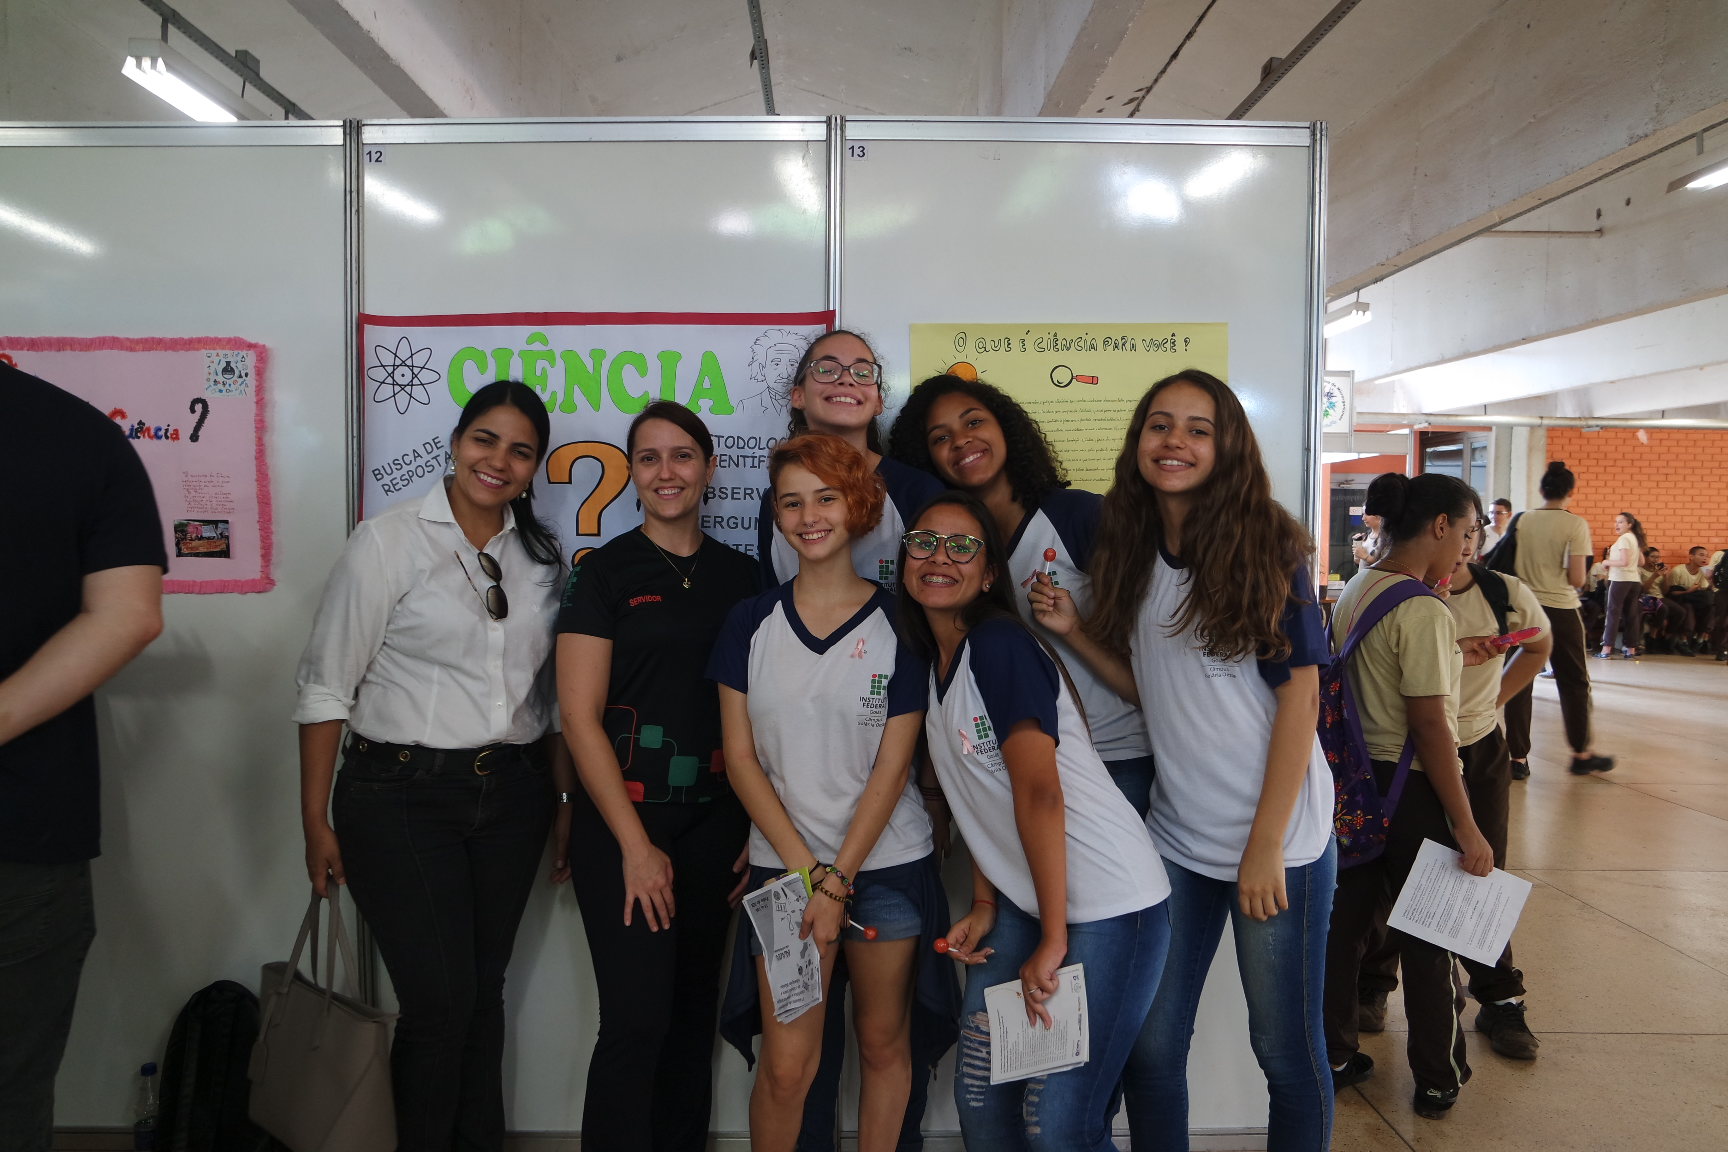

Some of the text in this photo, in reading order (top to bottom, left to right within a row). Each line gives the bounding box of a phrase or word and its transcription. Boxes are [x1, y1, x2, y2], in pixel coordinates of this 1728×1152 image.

[365, 150, 383, 163] 12
[848, 145, 866, 158] 13
[953, 331, 968, 353] O
[974, 336, 1012, 354] QUE
[1018, 329, 1031, 352] É
[1102, 335, 1137, 352] PARA
[1142, 332, 1177, 352] VOCÊ
[1183, 337, 1191, 352] ?
[447, 331, 735, 416] CIÊNCIA
[189, 397, 210, 443] ?
[371, 435, 444, 482] BUSCA DE
[629, 595, 662, 607] SERVIDOR
